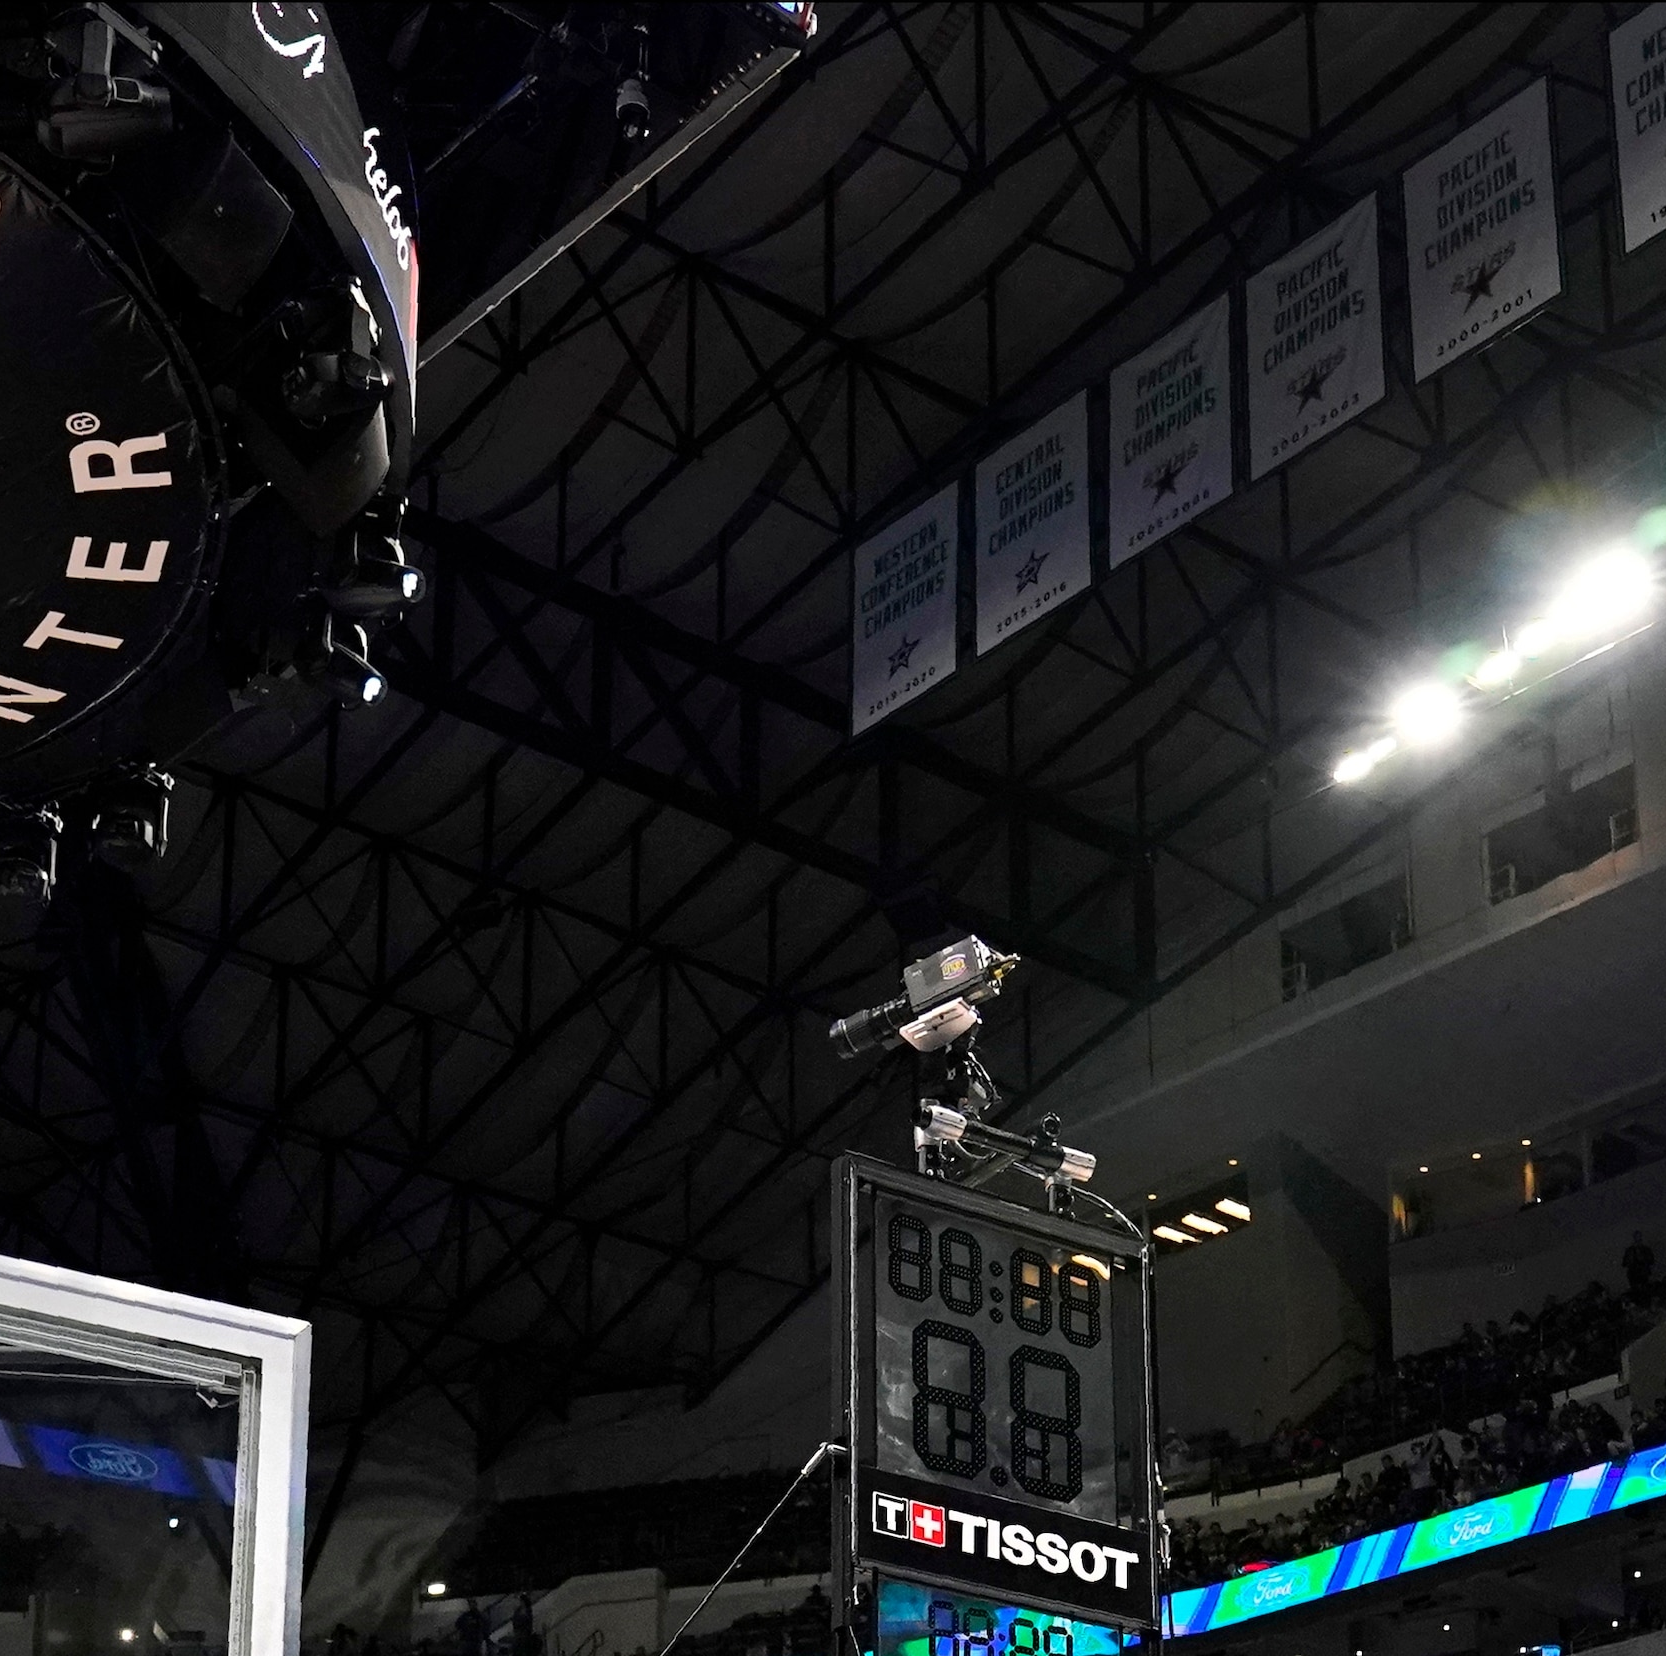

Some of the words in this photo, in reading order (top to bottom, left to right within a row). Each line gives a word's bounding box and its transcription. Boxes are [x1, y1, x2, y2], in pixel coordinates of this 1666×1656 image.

[1436, 157, 1517, 230] DIVISION
[1437, 130, 1514, 199] PACIFIC
[1424, 180, 1535, 270] CHAMPIONS
[1274, 267, 1349, 336] DIVISION
[1276, 240, 1343, 307] PACIFIC
[1263, 290, 1364, 375] CHAMPIONS
[1436, 288, 1534, 357] 2000-2001
[948, 1510, 1139, 1591] TISSOT
[1448, 1513, 1495, 1546] Ford
[1253, 1574, 1293, 1607] Ford
